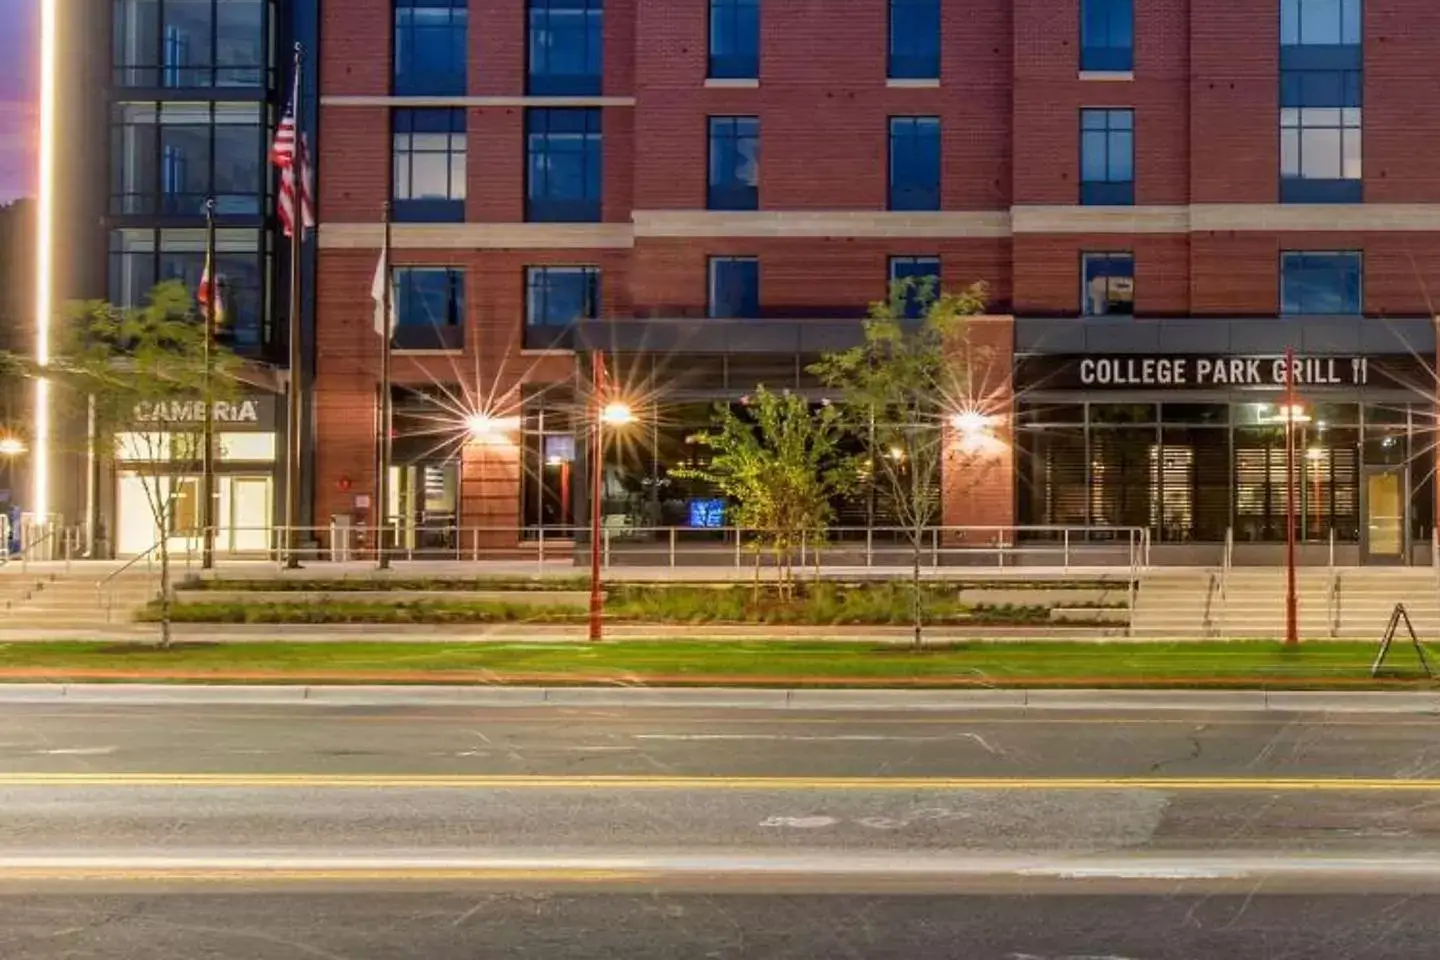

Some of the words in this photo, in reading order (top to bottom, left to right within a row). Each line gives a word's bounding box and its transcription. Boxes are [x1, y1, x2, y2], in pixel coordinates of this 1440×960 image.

[1080, 358, 1186, 383] COLLEGE
[1196, 358, 1261, 383] PARK
[1272, 358, 1341, 383] GRILL
